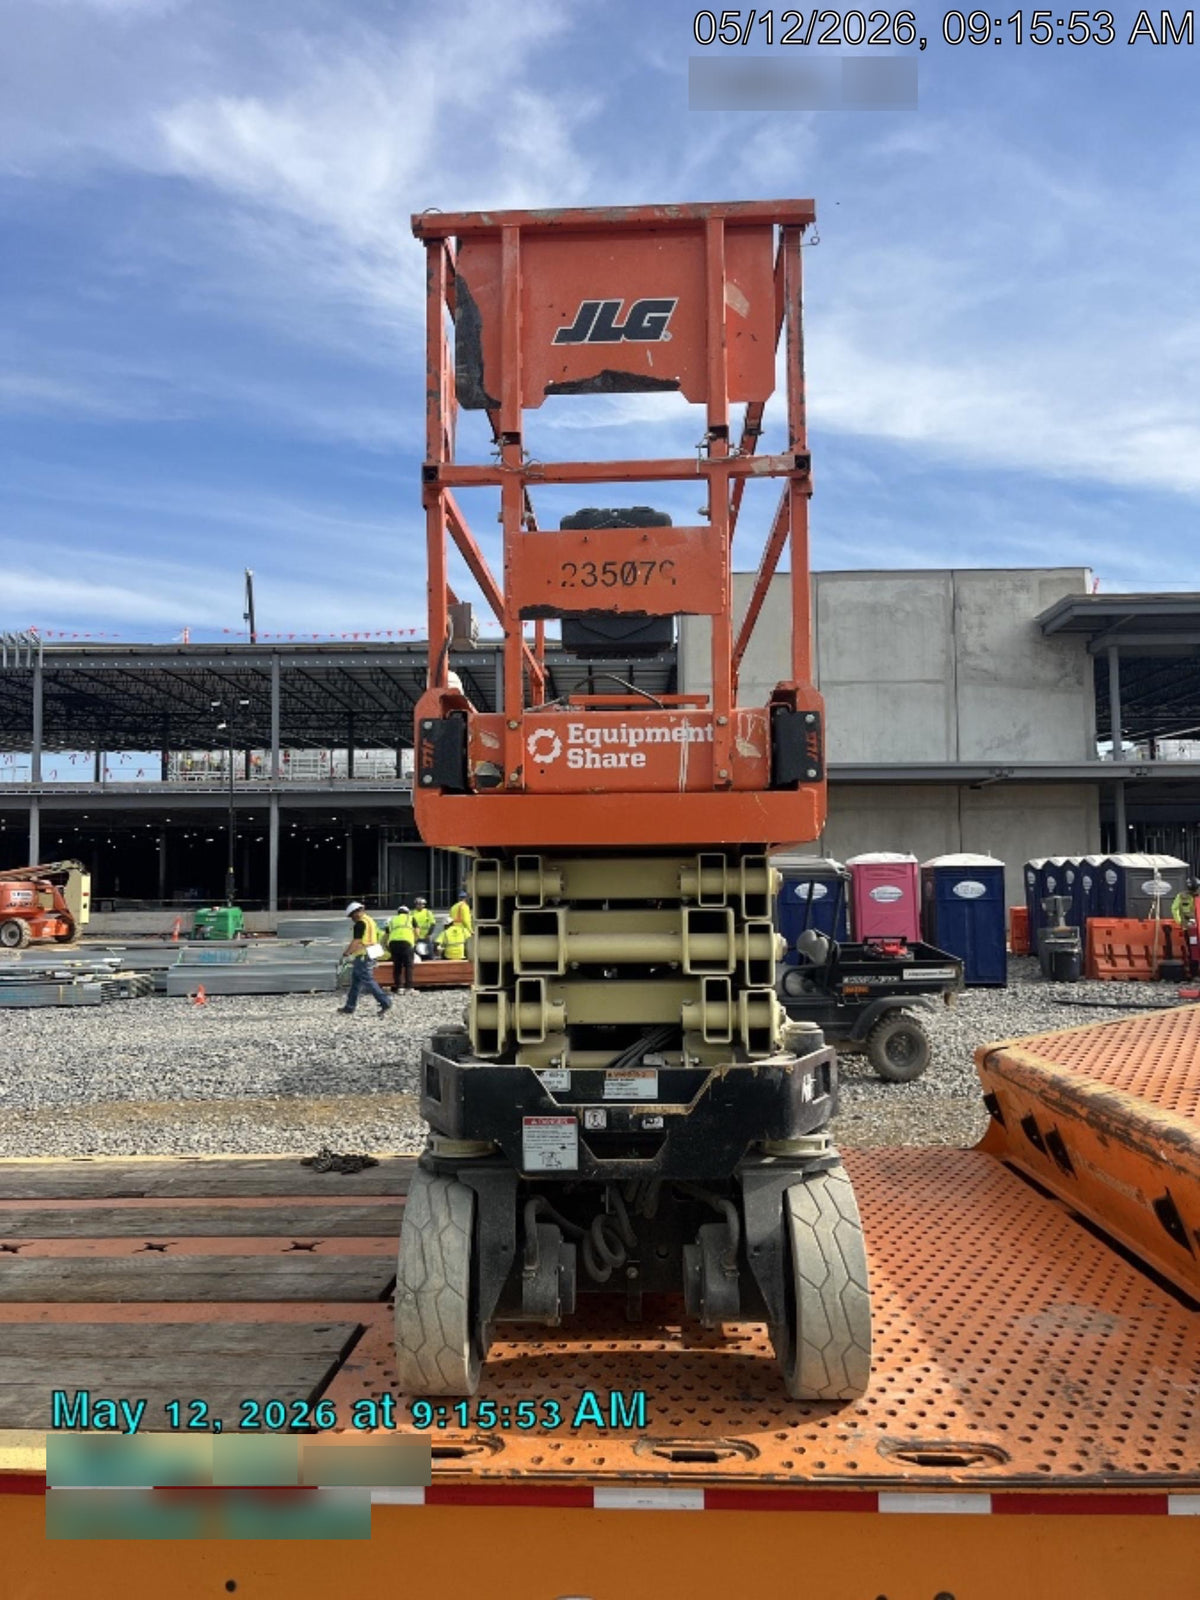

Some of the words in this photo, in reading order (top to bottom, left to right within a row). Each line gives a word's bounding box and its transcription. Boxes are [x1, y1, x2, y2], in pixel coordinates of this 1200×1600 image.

[551, 297, 679, 345] JLG
[566, 722, 713, 745] Equipment
[566, 747, 647, 768] Share
